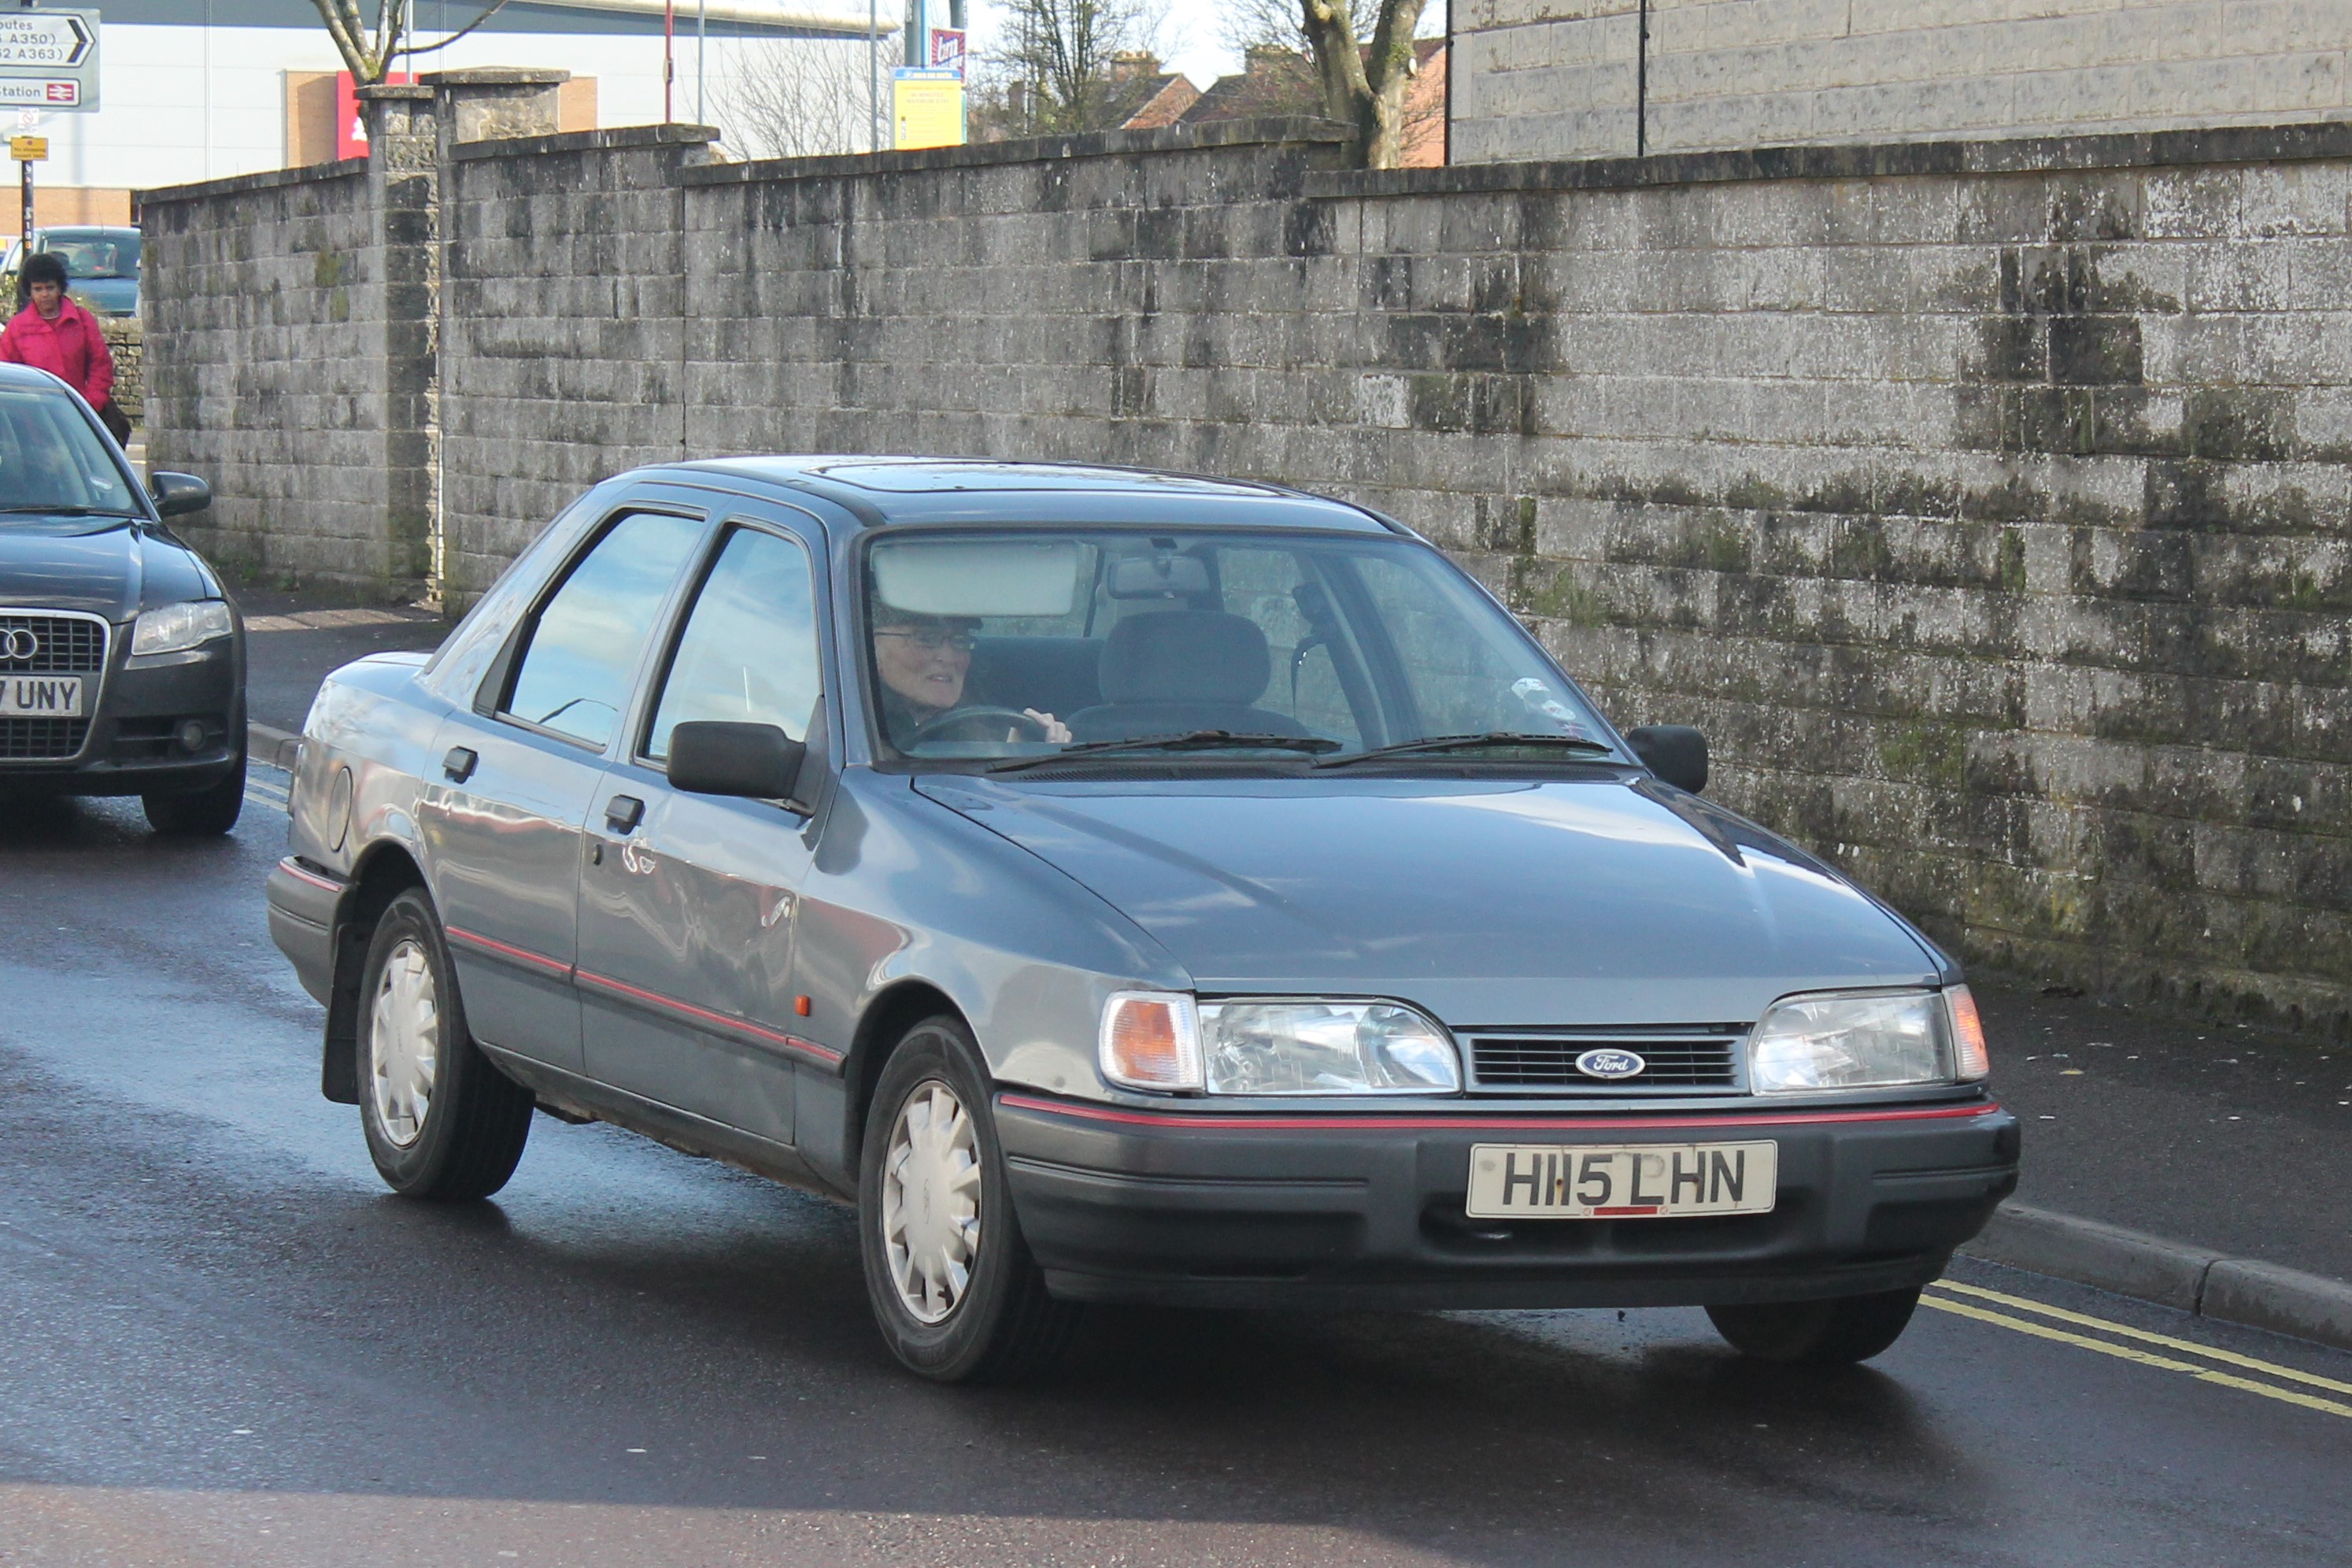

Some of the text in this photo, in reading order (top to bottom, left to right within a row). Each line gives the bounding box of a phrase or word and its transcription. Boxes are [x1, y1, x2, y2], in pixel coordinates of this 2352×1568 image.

[10, 33, 56, 46] A350)
[18, 48, 63, 61] A363)
[0, 86, 41, 97] tation
[17, 681, 76, 710] UNY
[1592, 1055, 1629, 1071] Ford
[1630, 1149, 1745, 1206] LHN
